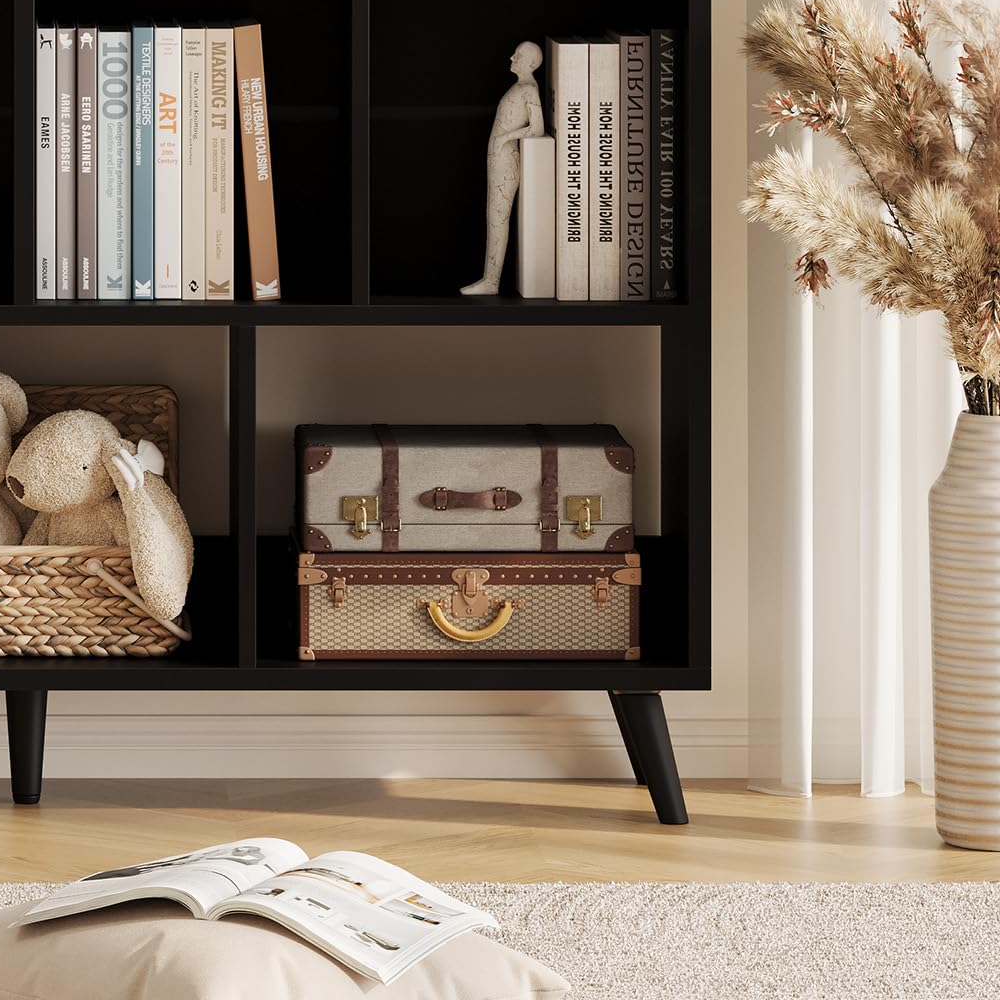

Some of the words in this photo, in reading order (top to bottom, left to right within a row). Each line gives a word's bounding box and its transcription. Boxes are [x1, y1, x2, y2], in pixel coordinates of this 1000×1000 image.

[142, 42, 151, 75] TEXTILE
[212, 41, 226, 108] MAKING
[102, 42, 128, 119] 1000
[241, 80, 250, 104] HILARY
[251, 77, 262, 99] NEW
[61, 93, 70, 119] ARNE
[82, 97, 91, 121] EERO
[142, 78, 151, 125] DESIGNERS
[159, 92, 176, 134] ART
[194, 99, 199, 108] of
[253, 101, 264, 135] URBAN
[41, 117, 49, 149] EAMES
[212, 113, 226, 130] IT
[243, 106, 253, 135] FRENCH
[61, 122, 70, 173] JACOBSEN
[82, 125, 91, 173] SAARINEN
[255, 137, 268, 181] HOUSING
